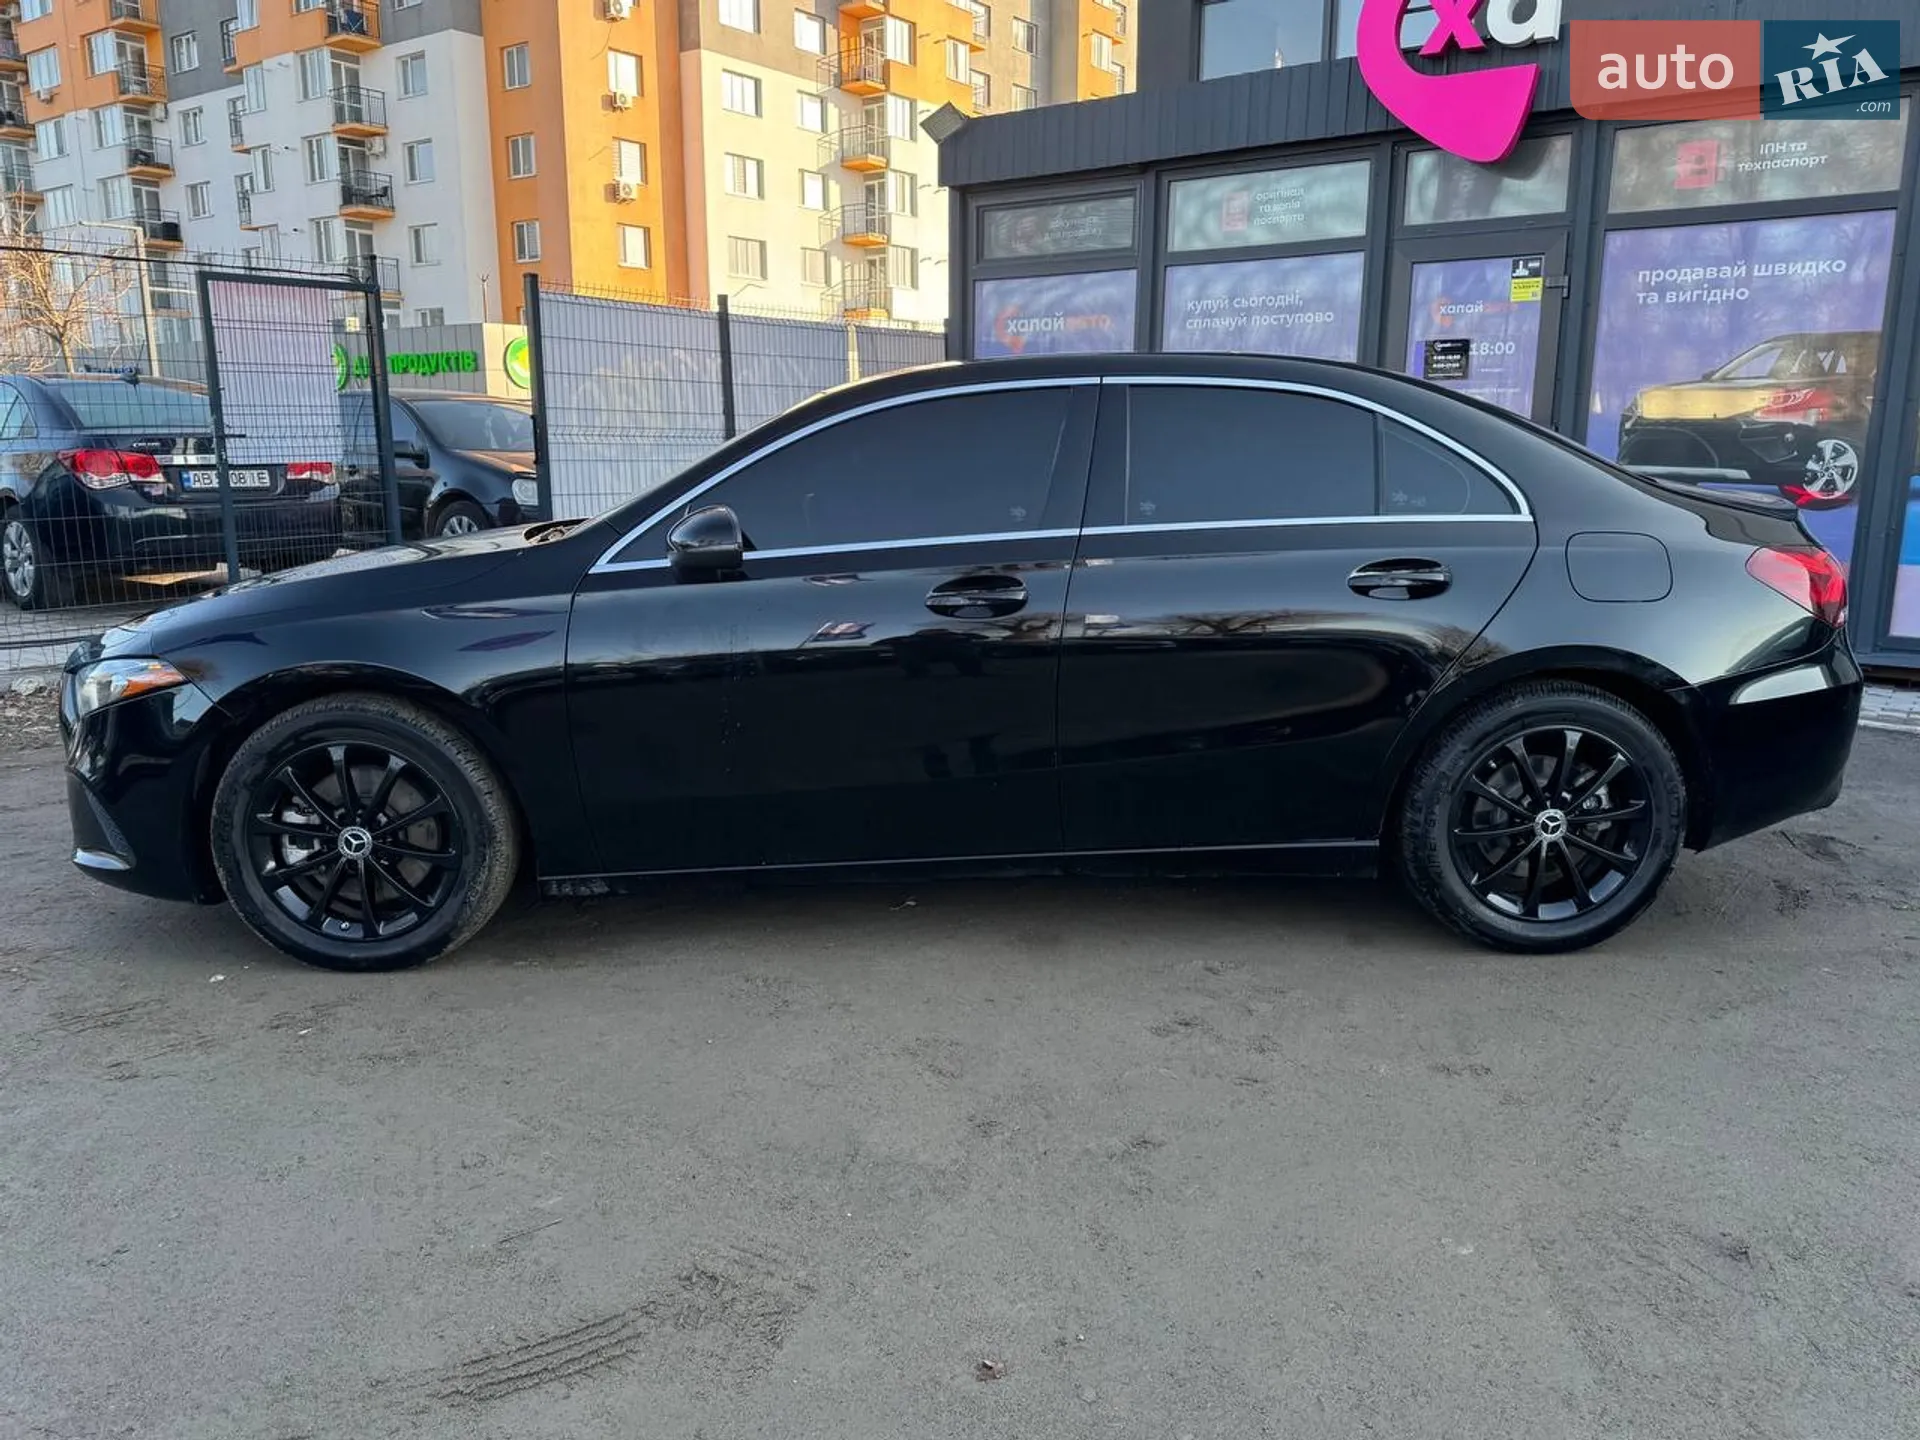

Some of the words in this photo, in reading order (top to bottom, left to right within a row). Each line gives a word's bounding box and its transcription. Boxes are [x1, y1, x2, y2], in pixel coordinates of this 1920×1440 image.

[1738, 154, 1829, 172] техпаспорт
[1638, 259, 1747, 285] продавай
[1753, 259, 1847, 277] швидко
[1186, 295, 1229, 314] купуй
[1233, 289, 1304, 309] сьогодні,
[1637, 291, 1659, 305] та
[1665, 284, 1750, 304] вигідно
[1186, 313, 1248, 331] сплачуй
[1251, 311, 1335, 328] поступово
[1469, 341, 1515, 356] 18:00
